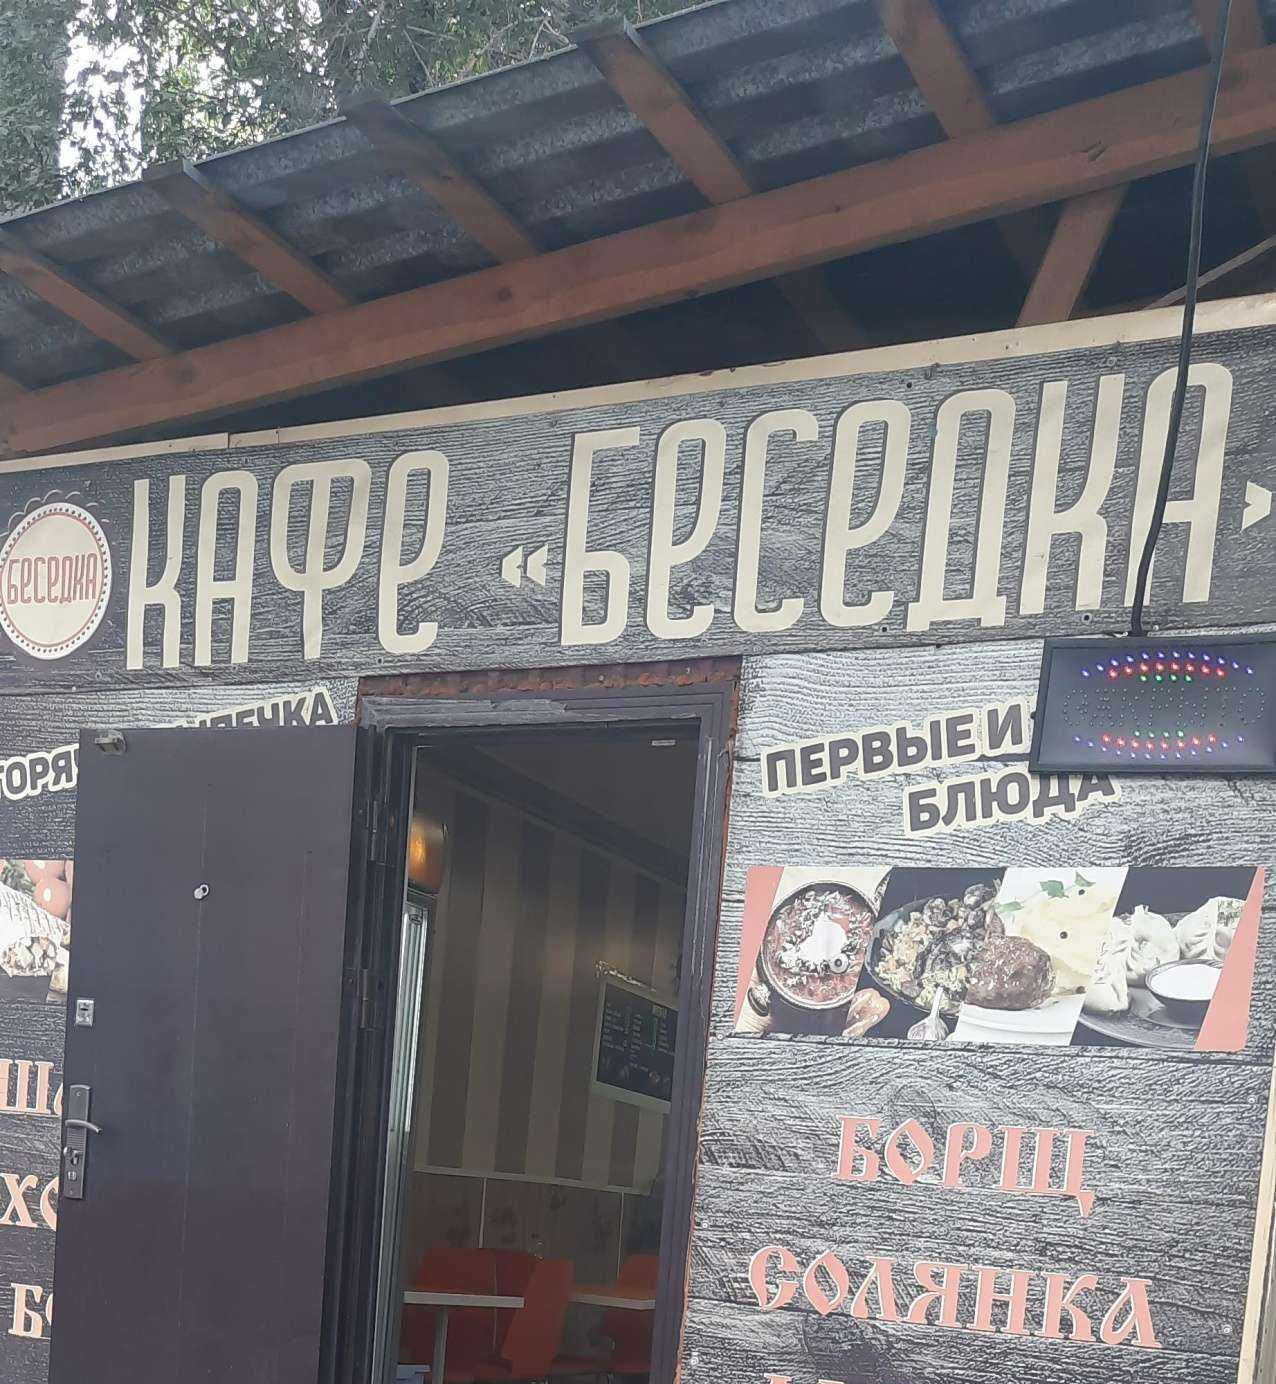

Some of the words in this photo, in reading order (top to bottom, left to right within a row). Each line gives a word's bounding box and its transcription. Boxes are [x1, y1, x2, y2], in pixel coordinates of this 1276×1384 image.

[7, 552, 98, 605] БЕСЕДКА
[126, 449, 450, 670] КАФЕ
[766, 713, 976, 793] ПЕРВЫЕ
[986, 703, 1024, 750] И
[907, 772, 1116, 832] БЛЮДА
[836, 1114, 1097, 1220] БОРЩ
[748, 1244, 1162, 1349] СОЛЯНКА
